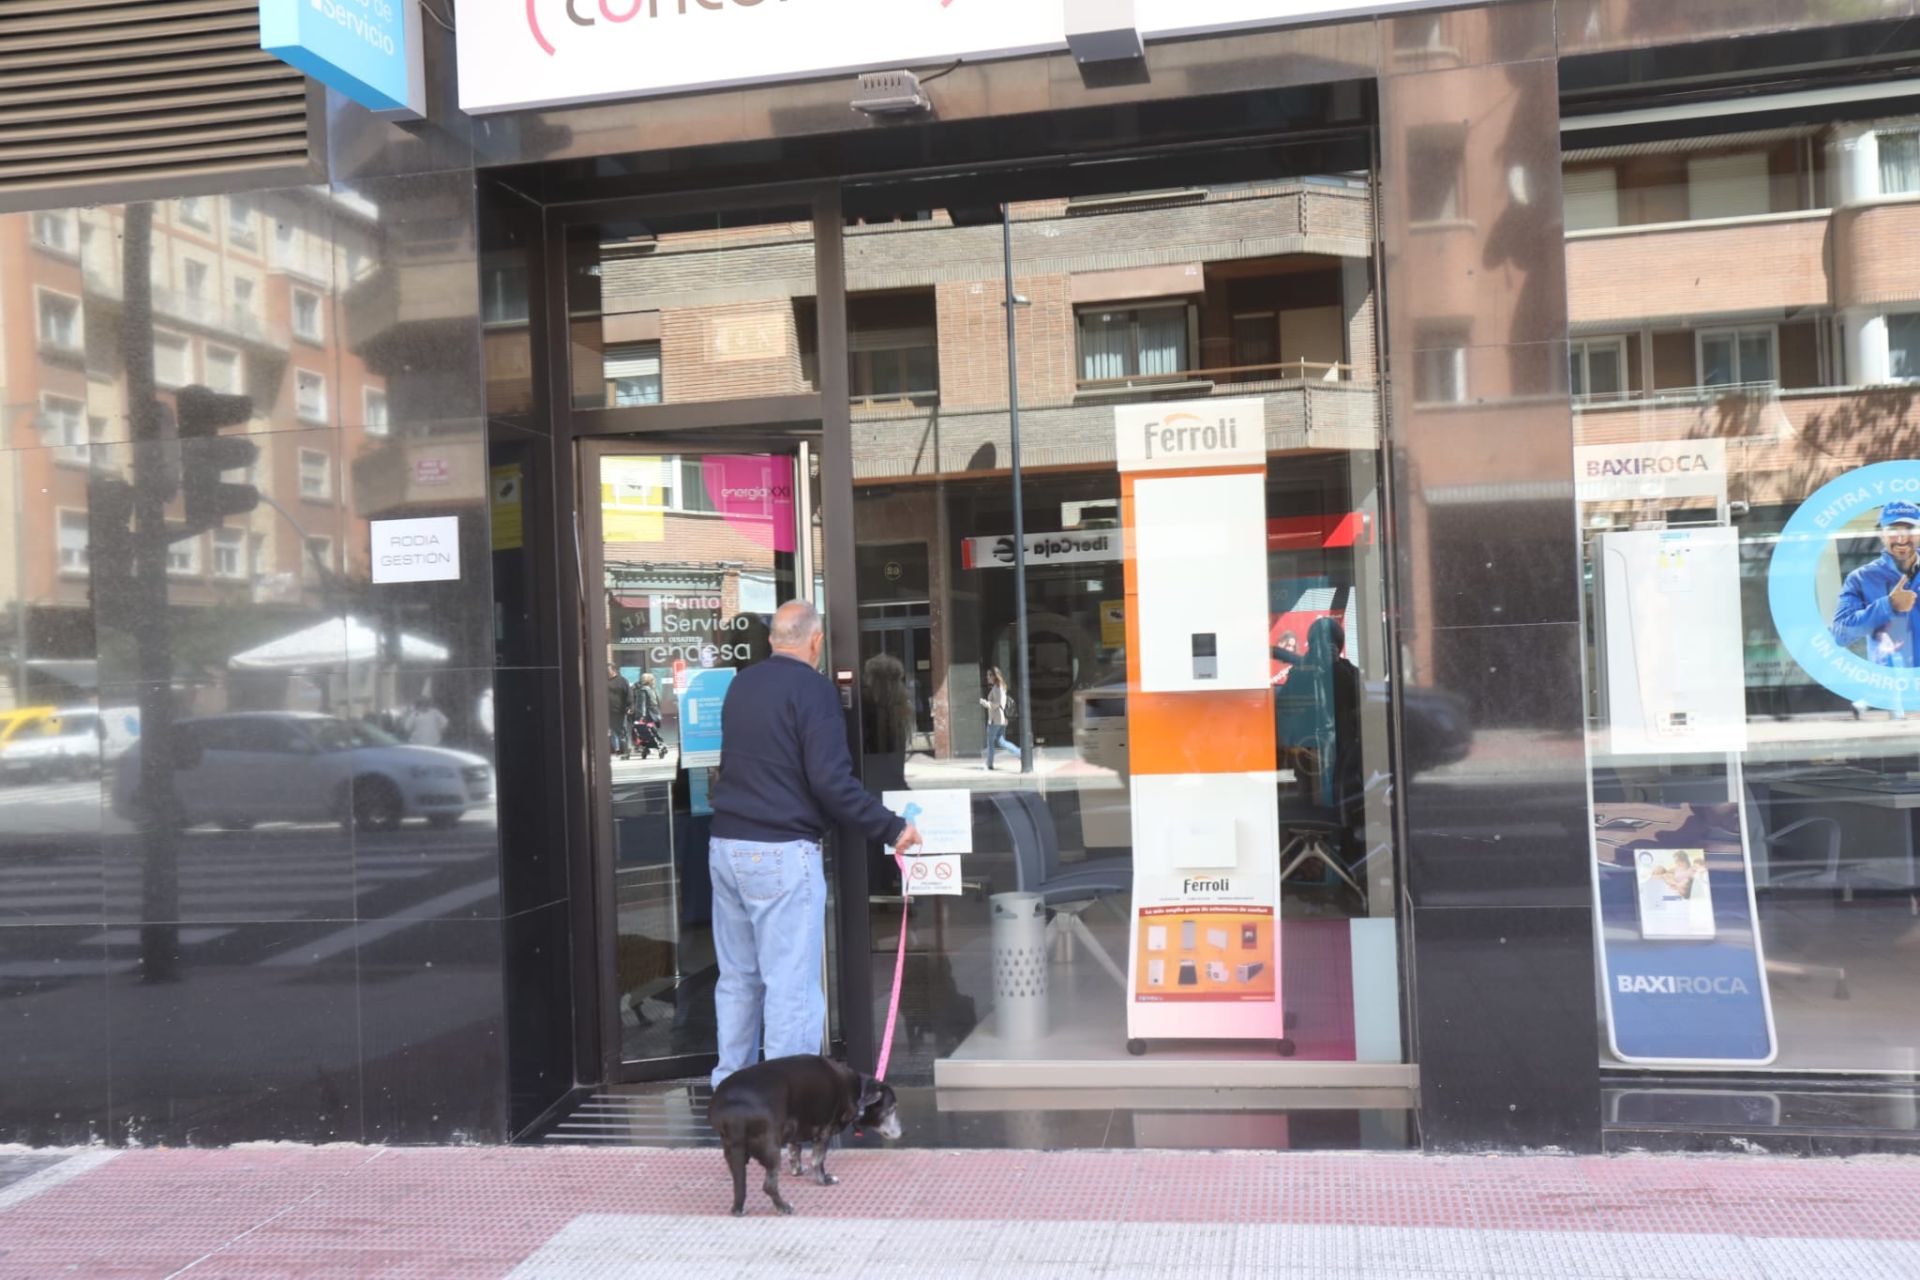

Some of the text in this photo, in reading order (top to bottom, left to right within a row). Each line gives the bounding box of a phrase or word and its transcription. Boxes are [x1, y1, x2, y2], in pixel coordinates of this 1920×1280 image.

[1144, 417, 1237, 459] Ferroli
[1586, 454, 1709, 477] BAXIROCA
[1814, 486, 1871, 528] ENTRA
[1872, 481, 1885, 495] Y
[390, 535, 440, 548] RODIA
[664, 613, 749, 632] Servicio
[651, 642, 751, 663] endesa
[1811, 633, 1834, 658] UN
[1831, 656, 1908, 691] AHORRO
[1184, 878, 1229, 894] Ferroli
[1616, 974, 1749, 994] BAXIROCA
